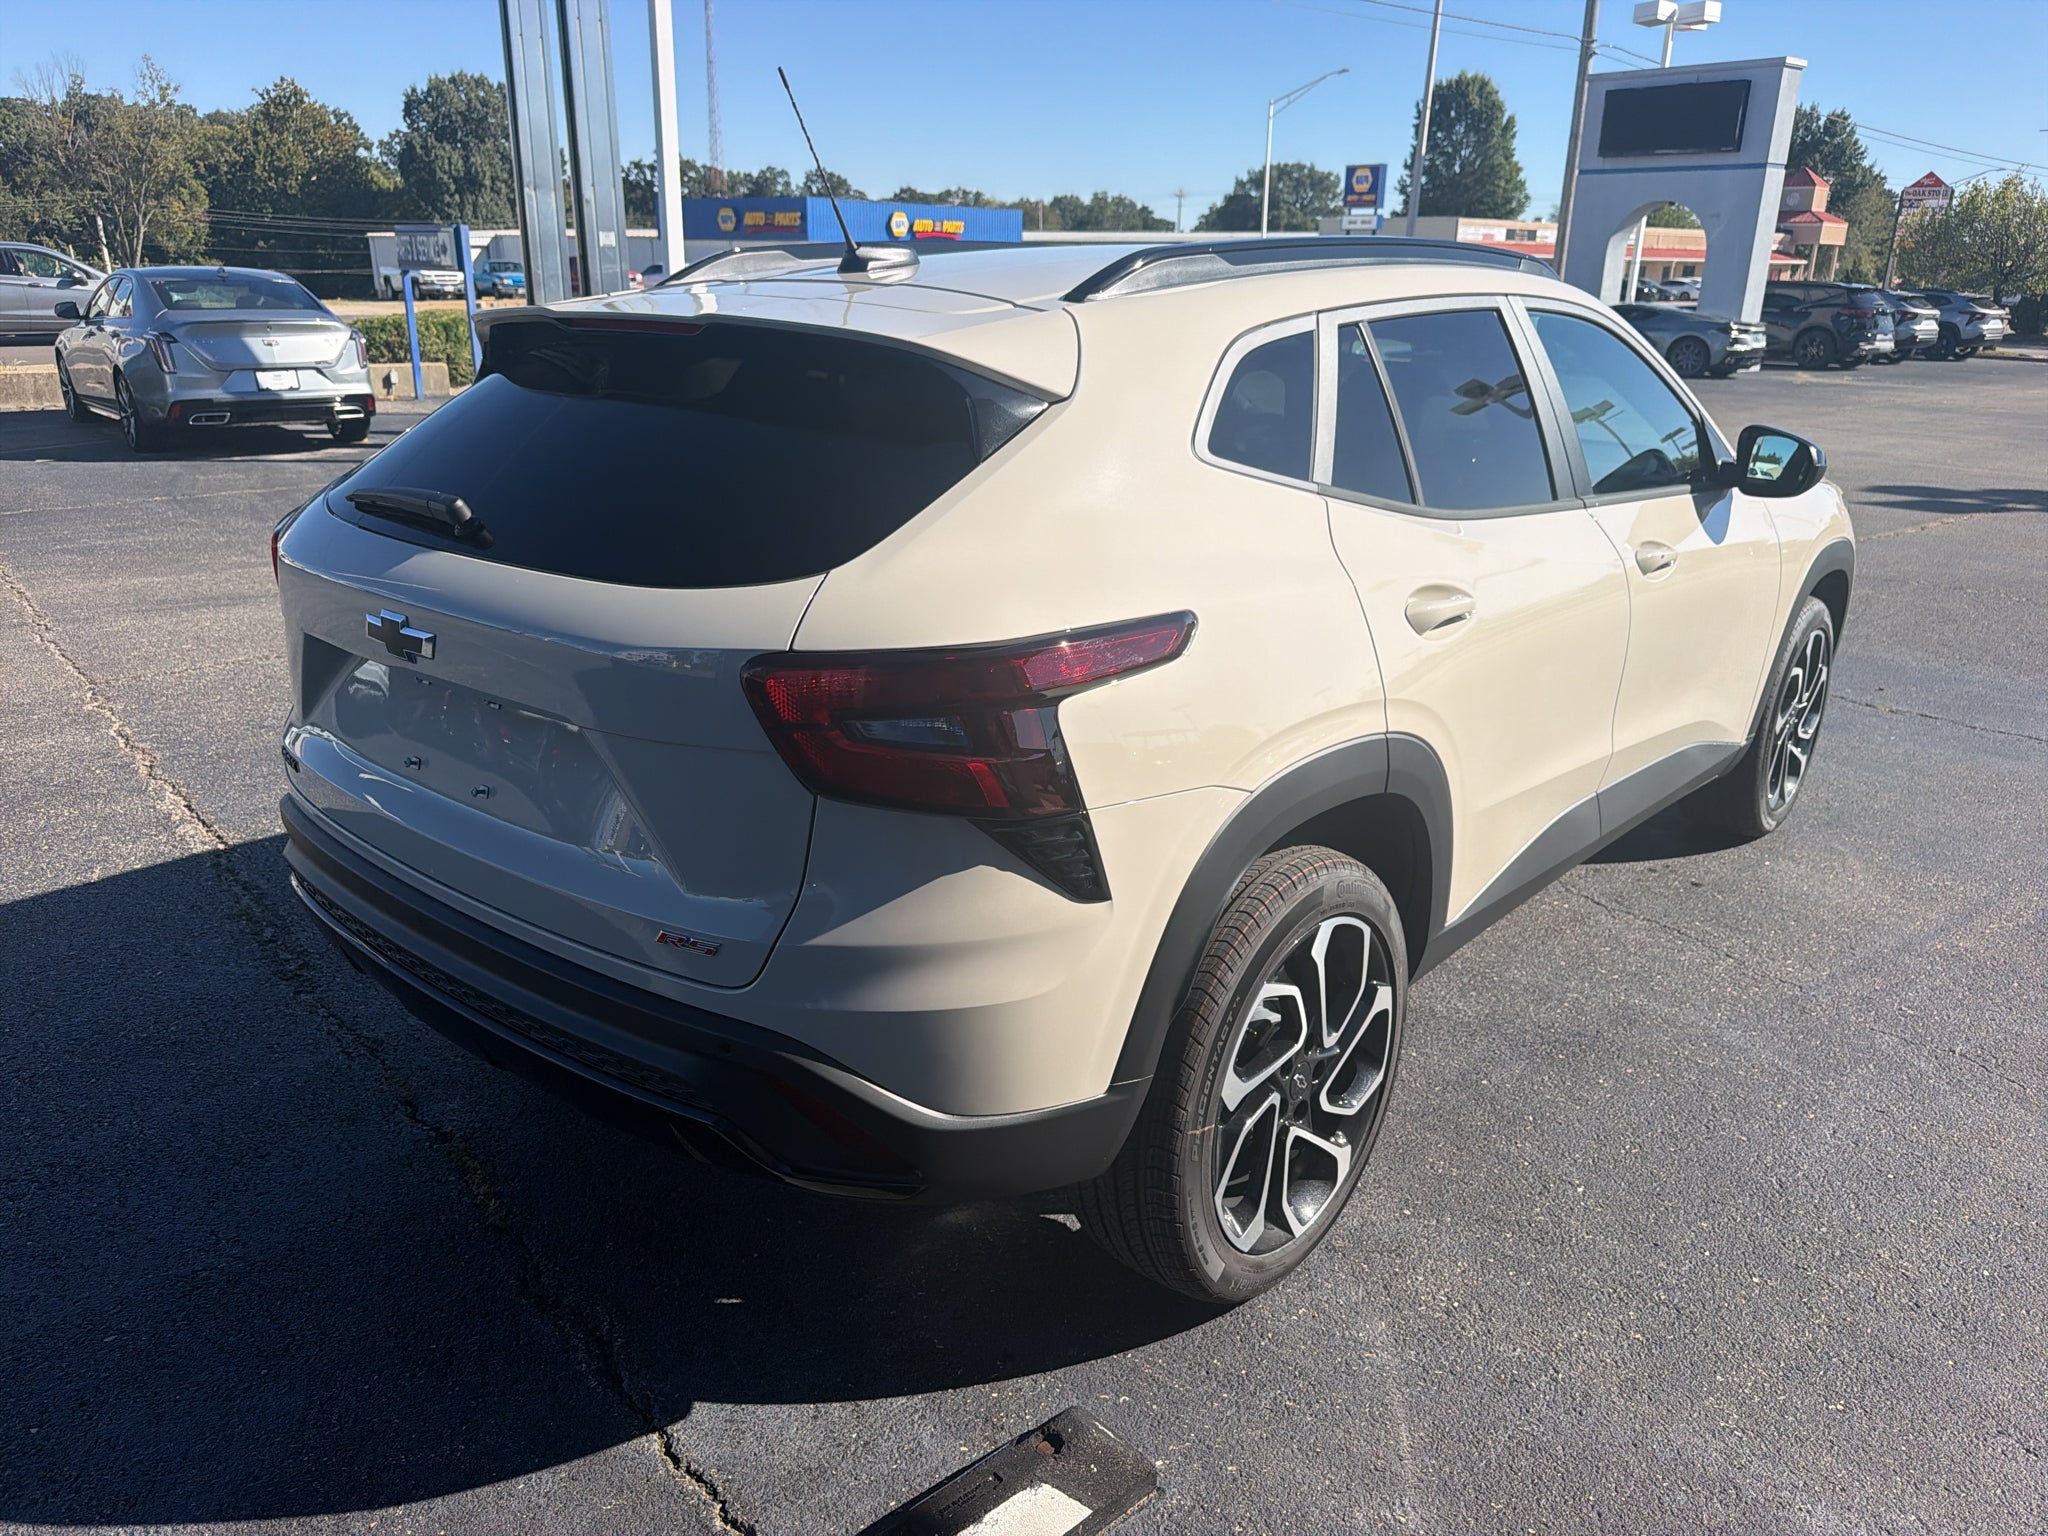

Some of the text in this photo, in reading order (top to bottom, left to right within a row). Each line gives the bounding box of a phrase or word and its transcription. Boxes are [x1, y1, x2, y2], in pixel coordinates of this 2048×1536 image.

[1912, 189, 1927, 197] OAK
[743, 211, 766, 226] AUTO
[774, 211, 801, 226] PARTS
[912, 219, 934, 233] AUTO
[942, 219, 965, 234] PARTS
[656, 930, 722, 957] RS
